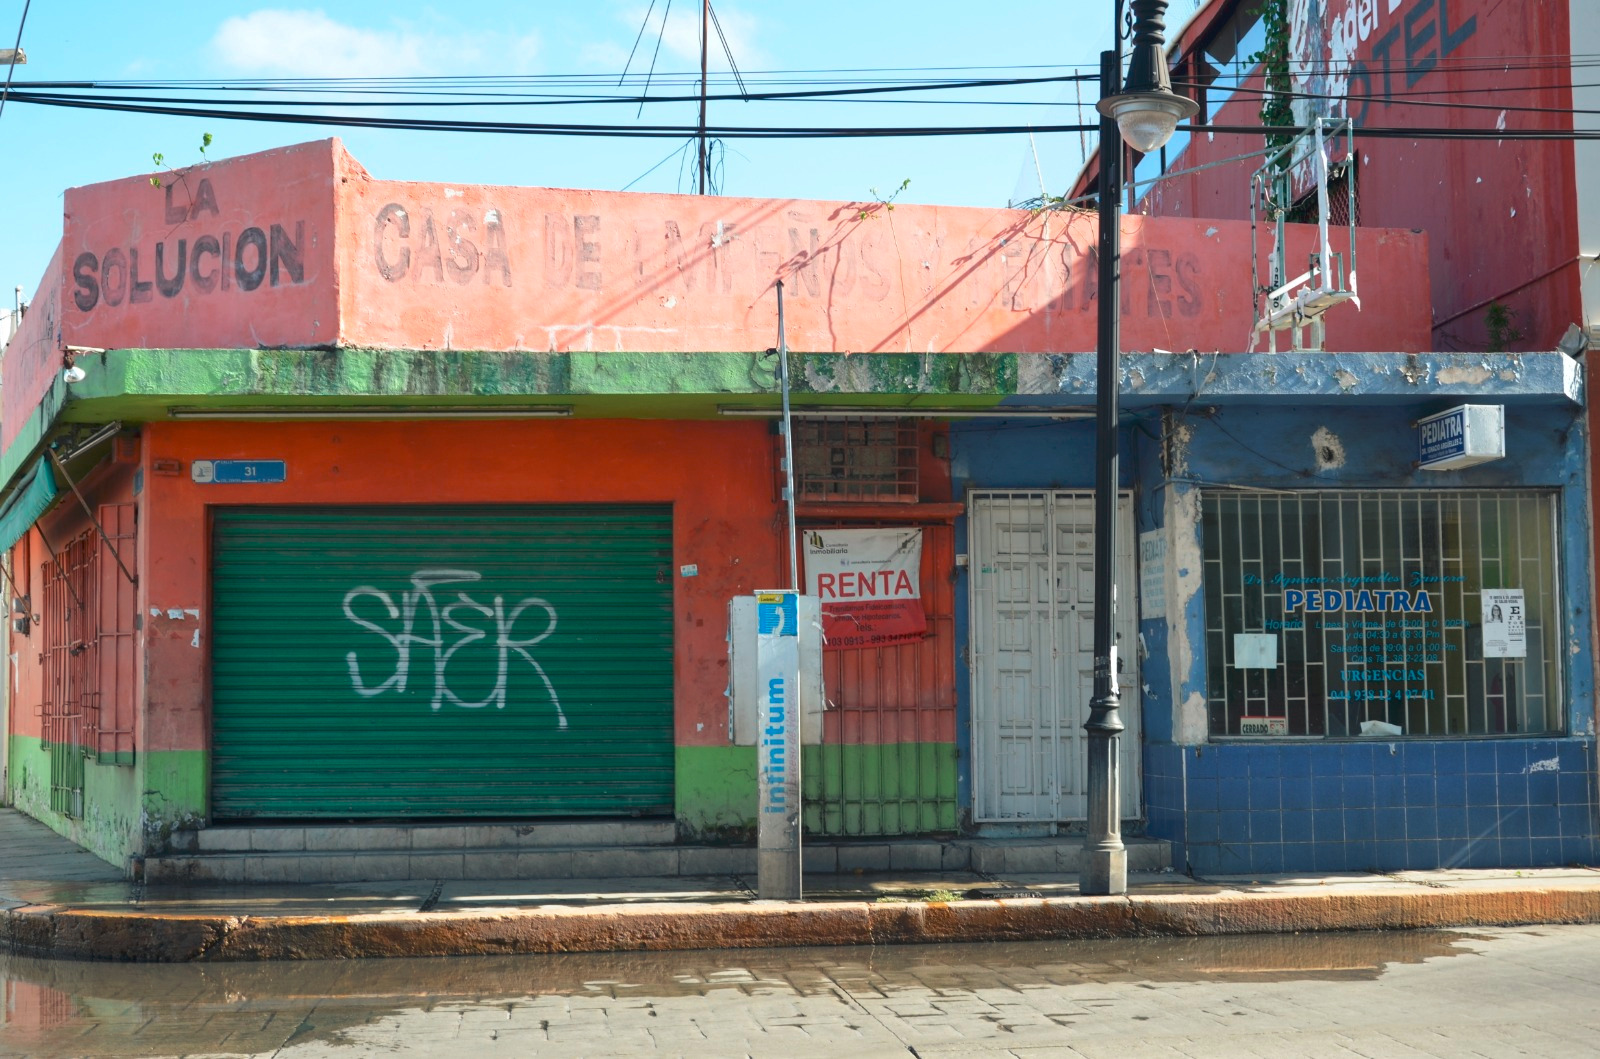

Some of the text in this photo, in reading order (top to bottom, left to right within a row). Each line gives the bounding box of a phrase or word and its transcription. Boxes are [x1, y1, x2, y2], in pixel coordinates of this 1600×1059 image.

[1331, 0, 1477, 152] OTEL
[164, 177, 220, 225] LA
[374, 203, 512, 288] CASA
[544, 212, 601, 291] DE
[73, 220, 305, 313] SOLUCION
[1421, 414, 1463, 446] PEDIATRA
[244, 466, 256, 476] 31
[817, 569, 913, 599] RENTA
[1282, 589, 1433, 613] PEDIATRA
[1340, 669, 1425, 681] URGENCIAS
[1242, 723, 1269, 735] CERRADO
[764, 678, 785, 813] infinitum
